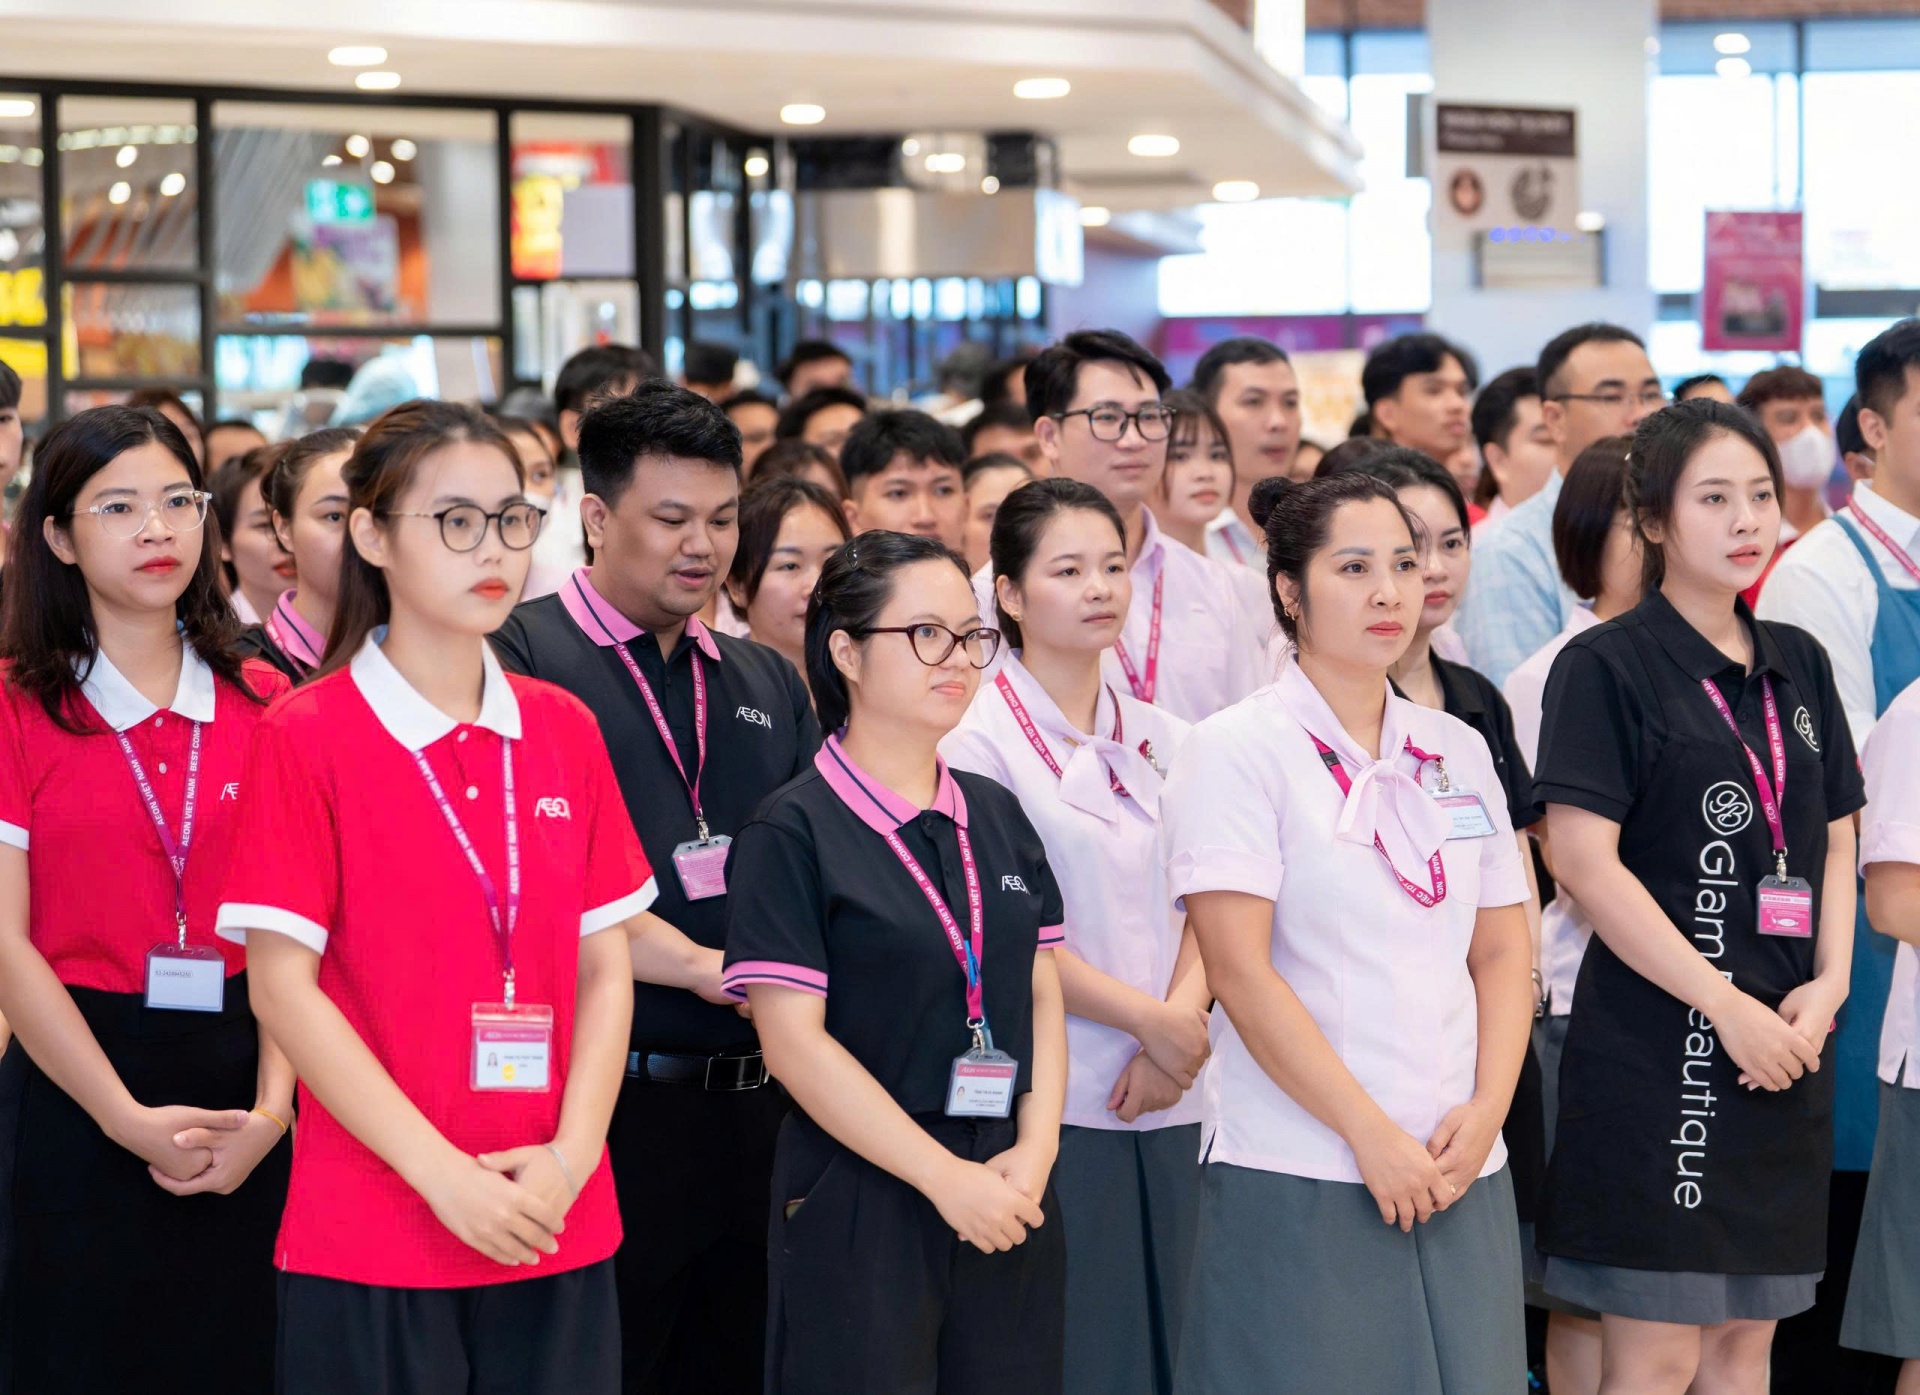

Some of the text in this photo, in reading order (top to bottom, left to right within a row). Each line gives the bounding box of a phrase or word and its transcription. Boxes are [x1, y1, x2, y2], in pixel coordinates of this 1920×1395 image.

[735, 706, 772, 729] AEON
[1766, 700, 1774, 718] BEST
[1770, 722, 1779, 740] NAM
[1773, 742, 1782, 757] VIET
[131, 759, 144, 780] NAM
[190, 750, 198, 771] BEST
[1750, 754, 1762, 775] AEON
[187, 778, 195, 798] NAM
[220, 782, 240, 800] AE
[150, 801, 165, 825] AEON
[185, 801, 193, 819] VIET
[182, 822, 191, 846] AEON
[908, 863, 925, 881] BEST
[1432, 855, 1440, 874] NAM
[967, 867, 976, 886] NAM
[926, 886, 941, 906] NAM
[1695, 840, 1738, 958] Glam
[939, 908, 951, 925] VIET
[949, 926, 963, 949] AEON
